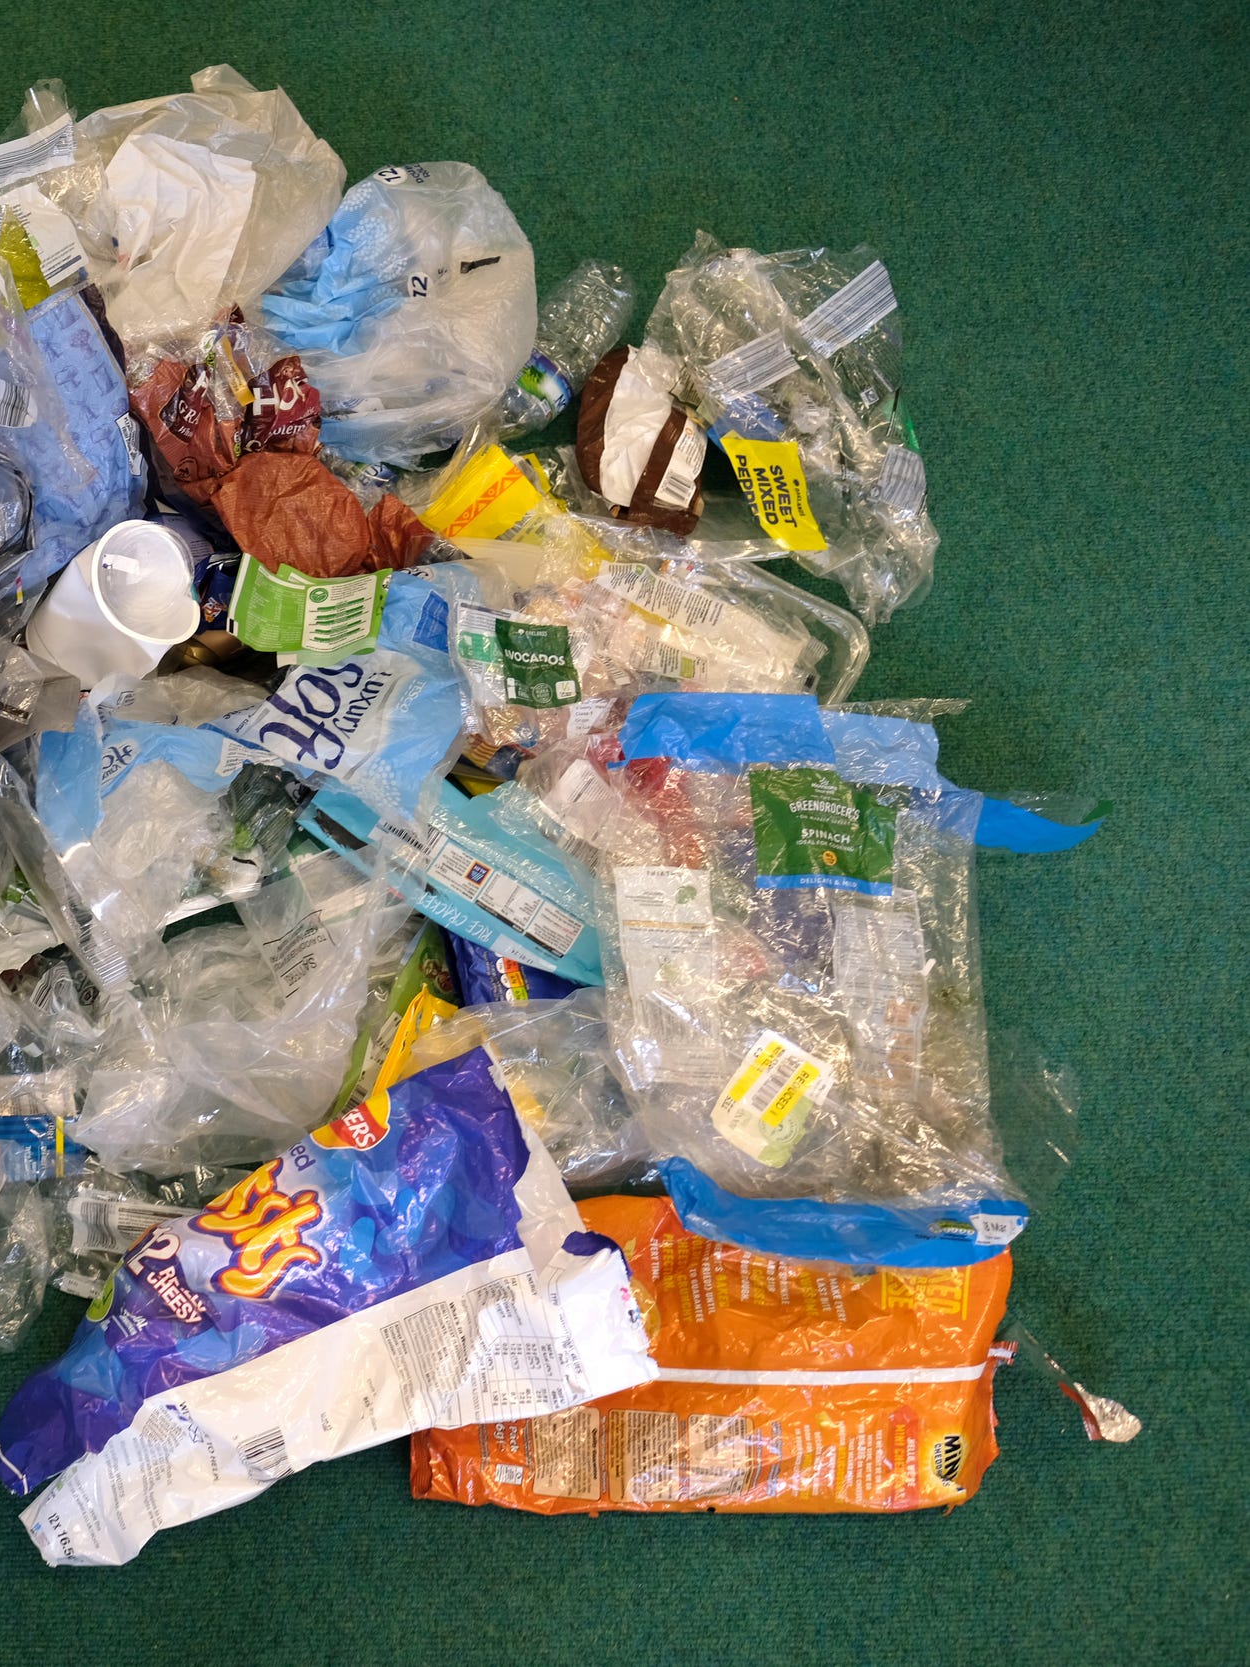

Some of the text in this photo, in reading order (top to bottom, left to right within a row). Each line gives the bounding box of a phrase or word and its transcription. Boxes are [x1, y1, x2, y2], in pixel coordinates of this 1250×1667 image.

[378, 166, 402, 183] 12
[411, 275, 428, 298] 12
[753, 468, 779, 525] MIXED
[770, 465, 798, 528] SWEET
[504, 648, 565, 666] AVOCADOS
[399, 679, 428, 714] TESCO
[259, 662, 364, 770] Soft
[789, 799, 861, 821] GREENGROCER'S
[802, 828, 851, 844] SPINACH
[466, 920, 495, 944] RICE
[775, 1070, 811, 1111] REDUCED
[146, 1271, 203, 1323] CHEESY
[715, 1273, 730, 1308] BAKED
[46, 1511, 62, 1532] 12x
